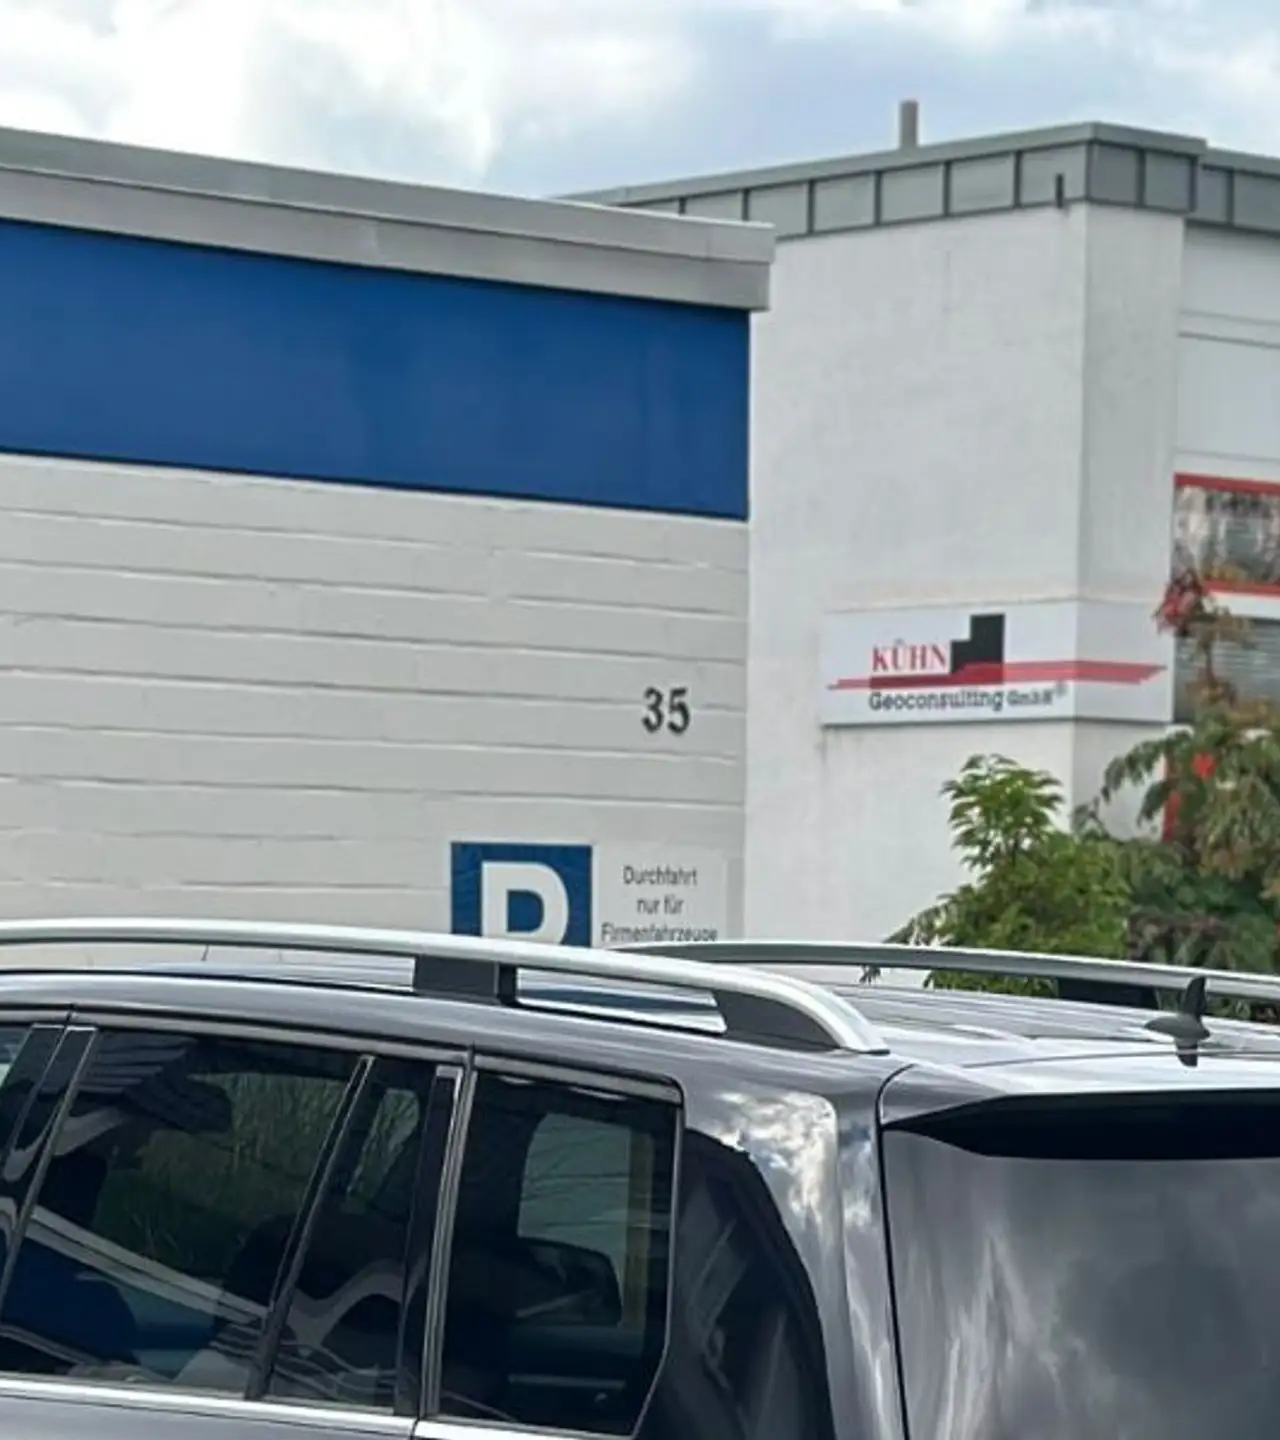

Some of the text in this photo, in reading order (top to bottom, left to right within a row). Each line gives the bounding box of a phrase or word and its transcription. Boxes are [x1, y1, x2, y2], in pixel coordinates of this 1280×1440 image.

[872, 638, 946, 672] KÜHN
[641, 687, 691, 736] 35
[869, 689, 1004, 712] Geoconsulting
[623, 865, 698, 886] Durchfahrt
[481, 860, 569, 945] P
[636, 894, 685, 915] nur für
